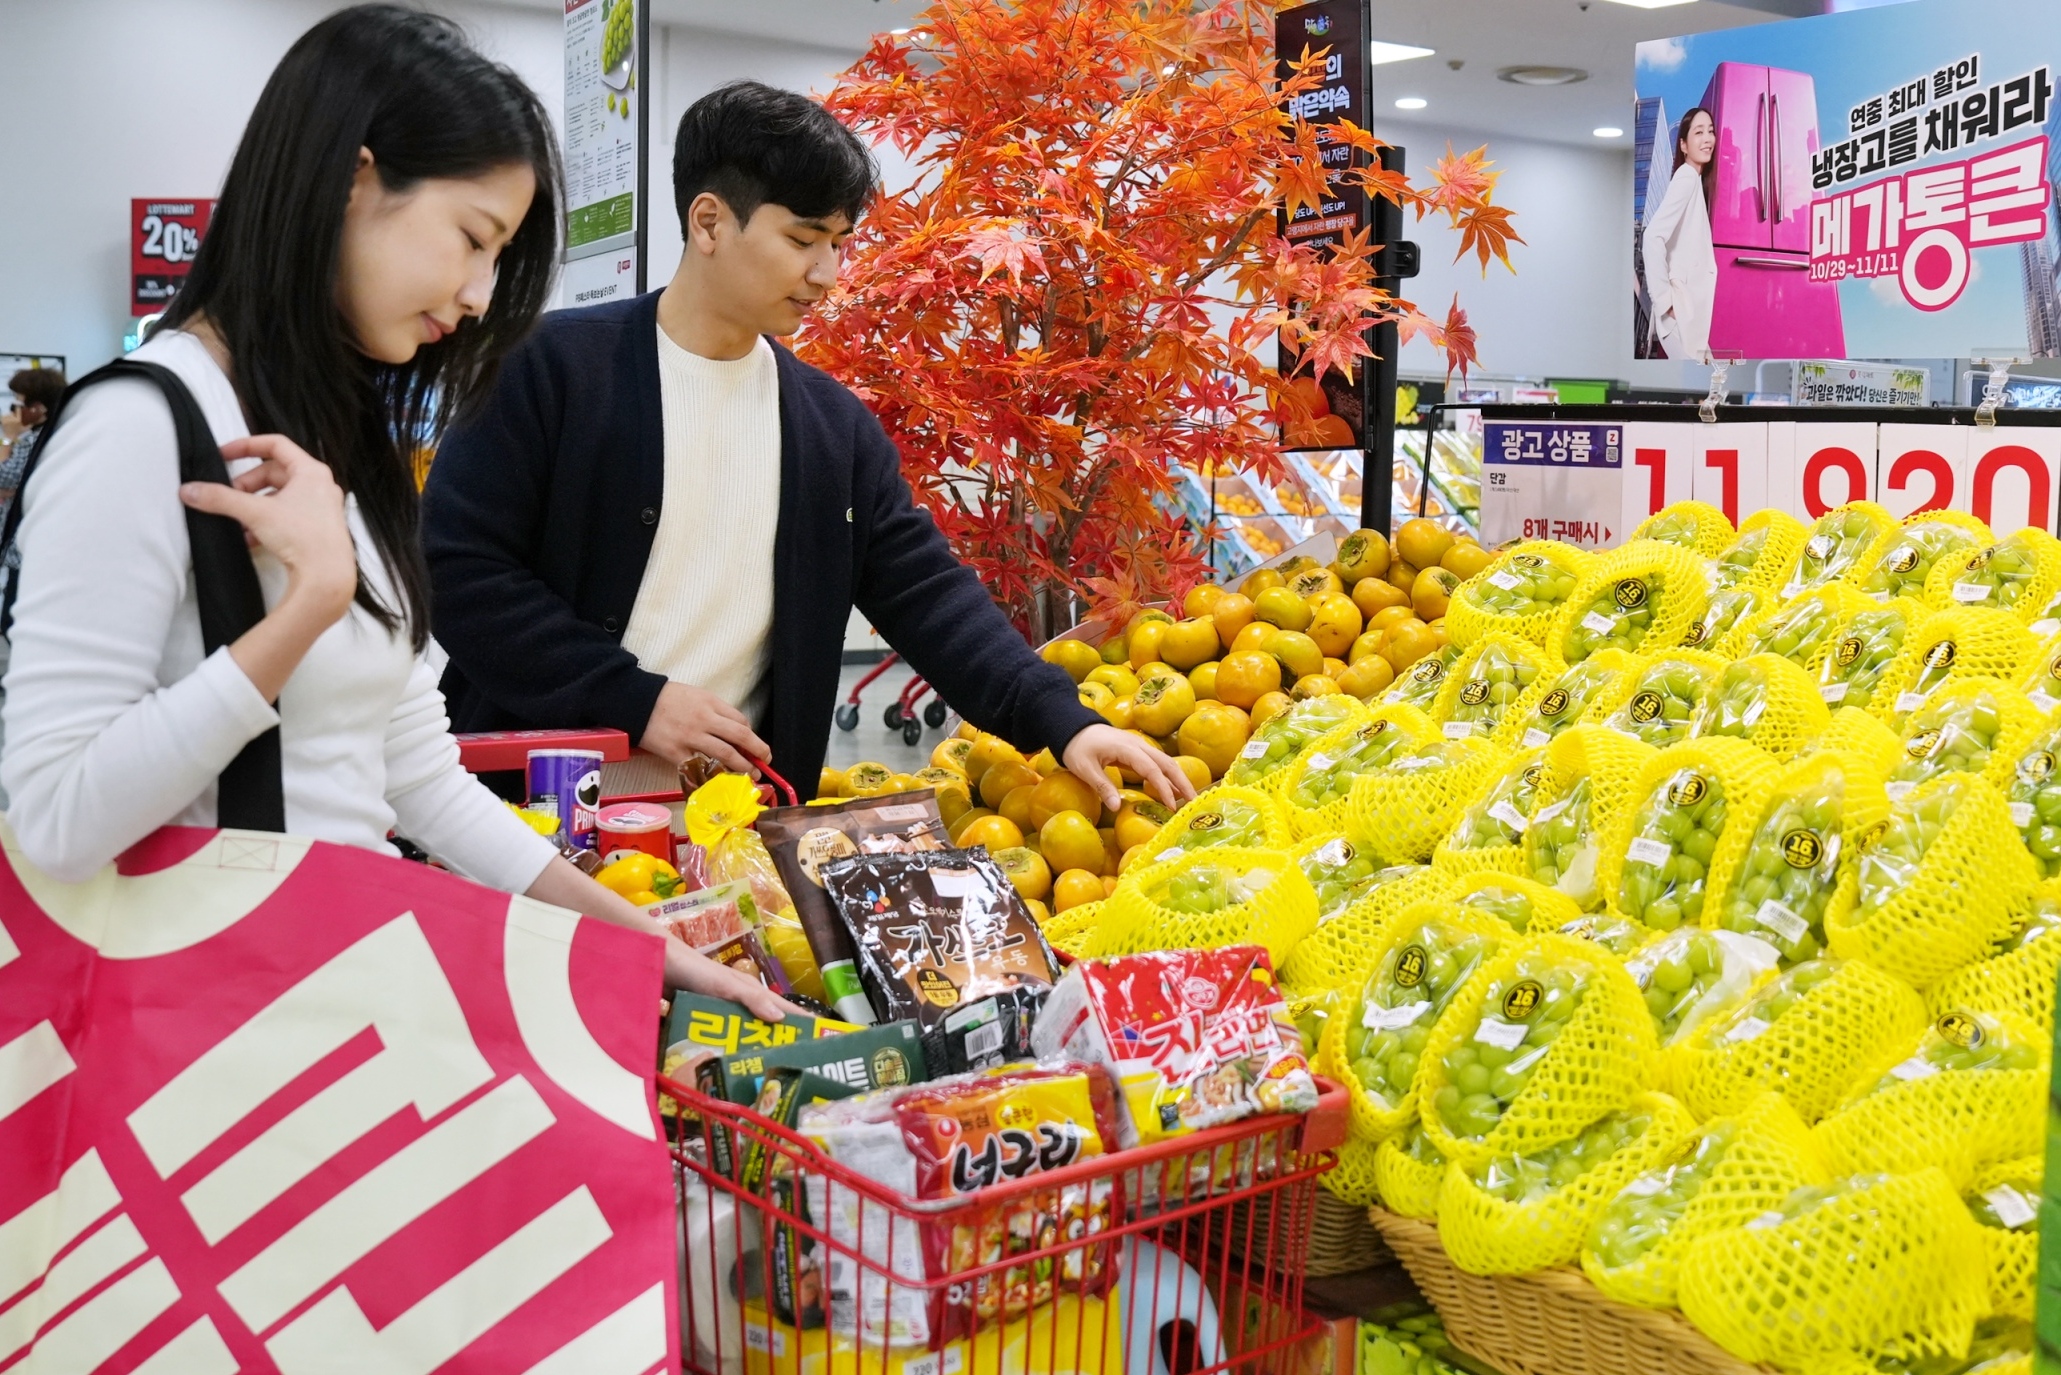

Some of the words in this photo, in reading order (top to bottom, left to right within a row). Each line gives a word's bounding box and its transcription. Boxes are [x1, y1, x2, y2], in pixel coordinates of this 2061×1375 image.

[1850, 97, 1883, 130] 연중
[1888, 78, 1927, 117] 최대
[1933, 55, 1978, 98] 할인
[1811, 116, 1919, 190] 냉장고를
[1923, 68, 2052, 155] 채워라
[1331, 146, 1350, 162] 자란
[141, 215, 200, 262] 20%
[1811, 142, 2046, 308] 메가통큰
[1810, 252, 1899, 281] 10/29~11/11
[1807, 383, 1834, 402] 과일은
[1836, 384, 1867, 402] 깎았다!
[1869, 388, 1888, 403] 당신은
[1501, 429, 1545, 461] 광고
[1547, 430, 1592, 463] 상품
[1489, 472, 1507, 485] 단감
[1523, 518, 1548, 540] 8개
[1551, 520, 1598, 544] 구매시
[990, 948, 1030, 972] 우동
[728, 1056, 764, 1077] 리챔
[952, 1118, 1080, 1191] 너구리
